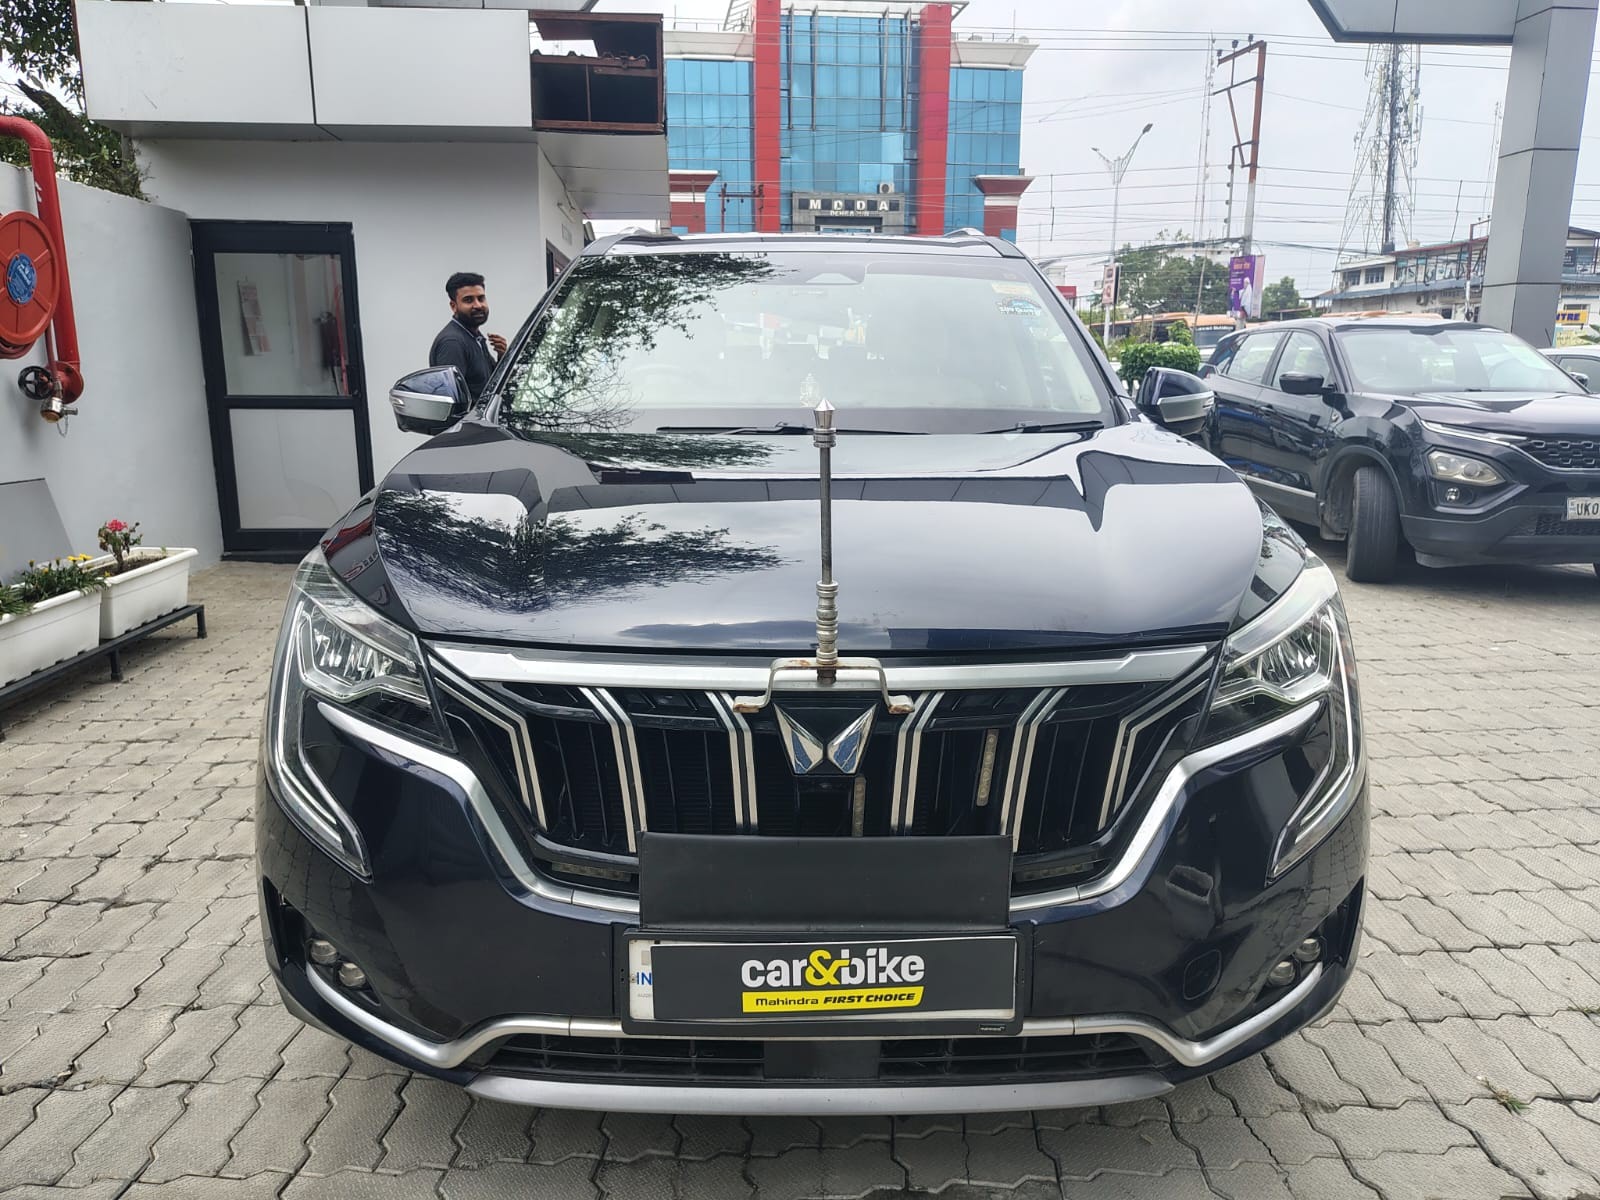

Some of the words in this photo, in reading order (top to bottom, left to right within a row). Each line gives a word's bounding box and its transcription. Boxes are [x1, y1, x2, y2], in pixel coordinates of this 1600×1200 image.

[741, 948, 925, 987] car&bike
[636, 971, 652, 985] IN
[755, 997, 819, 1006] Mahindra
[823, 994, 864, 1004] FIRST
[865, 993, 916, 1003] CHOICE
